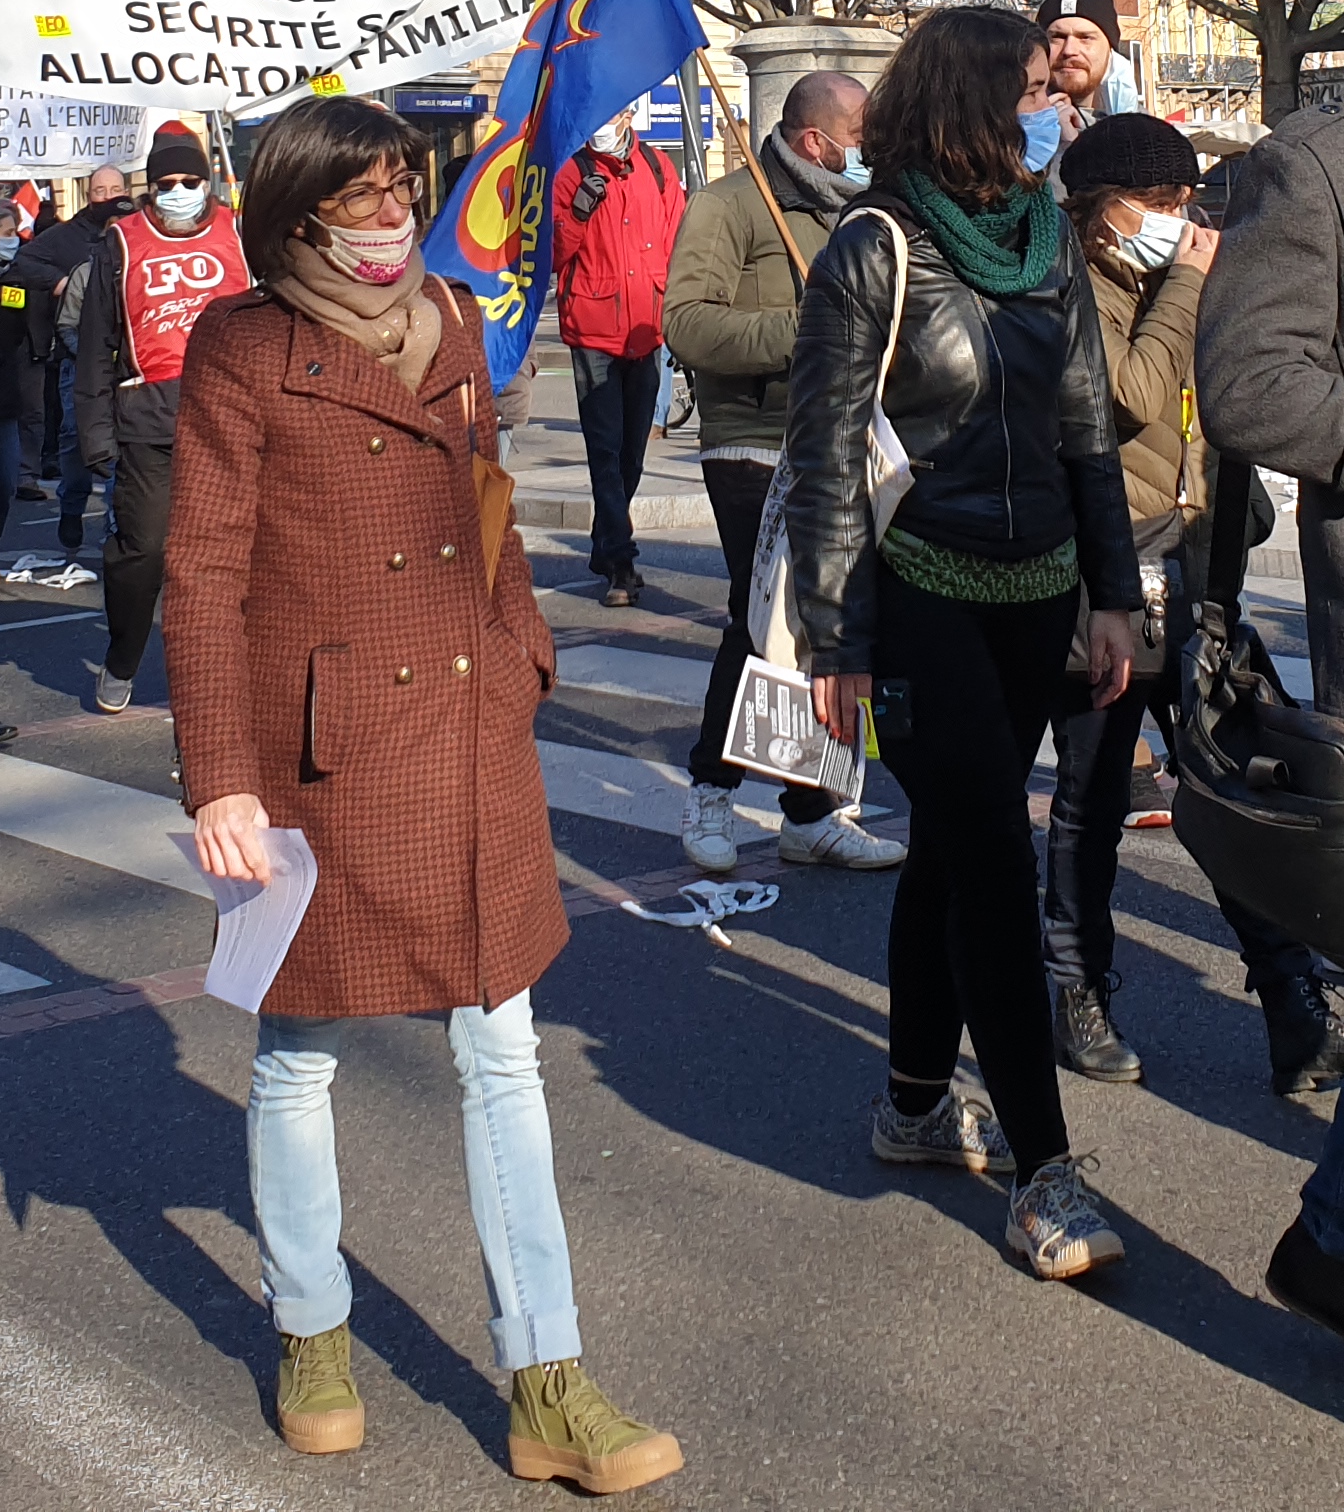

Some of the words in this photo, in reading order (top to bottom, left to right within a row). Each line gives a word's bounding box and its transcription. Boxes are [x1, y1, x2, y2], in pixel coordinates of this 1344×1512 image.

[18, 110, 32, 129] A
[47, 104, 142, 128] L'ENFUMAGE
[17, 135, 48, 158] AU
[71, 133, 136, 157] MEPRIS
[141, 251, 225, 297] FO
[742, 699, 757, 758] Anasse
